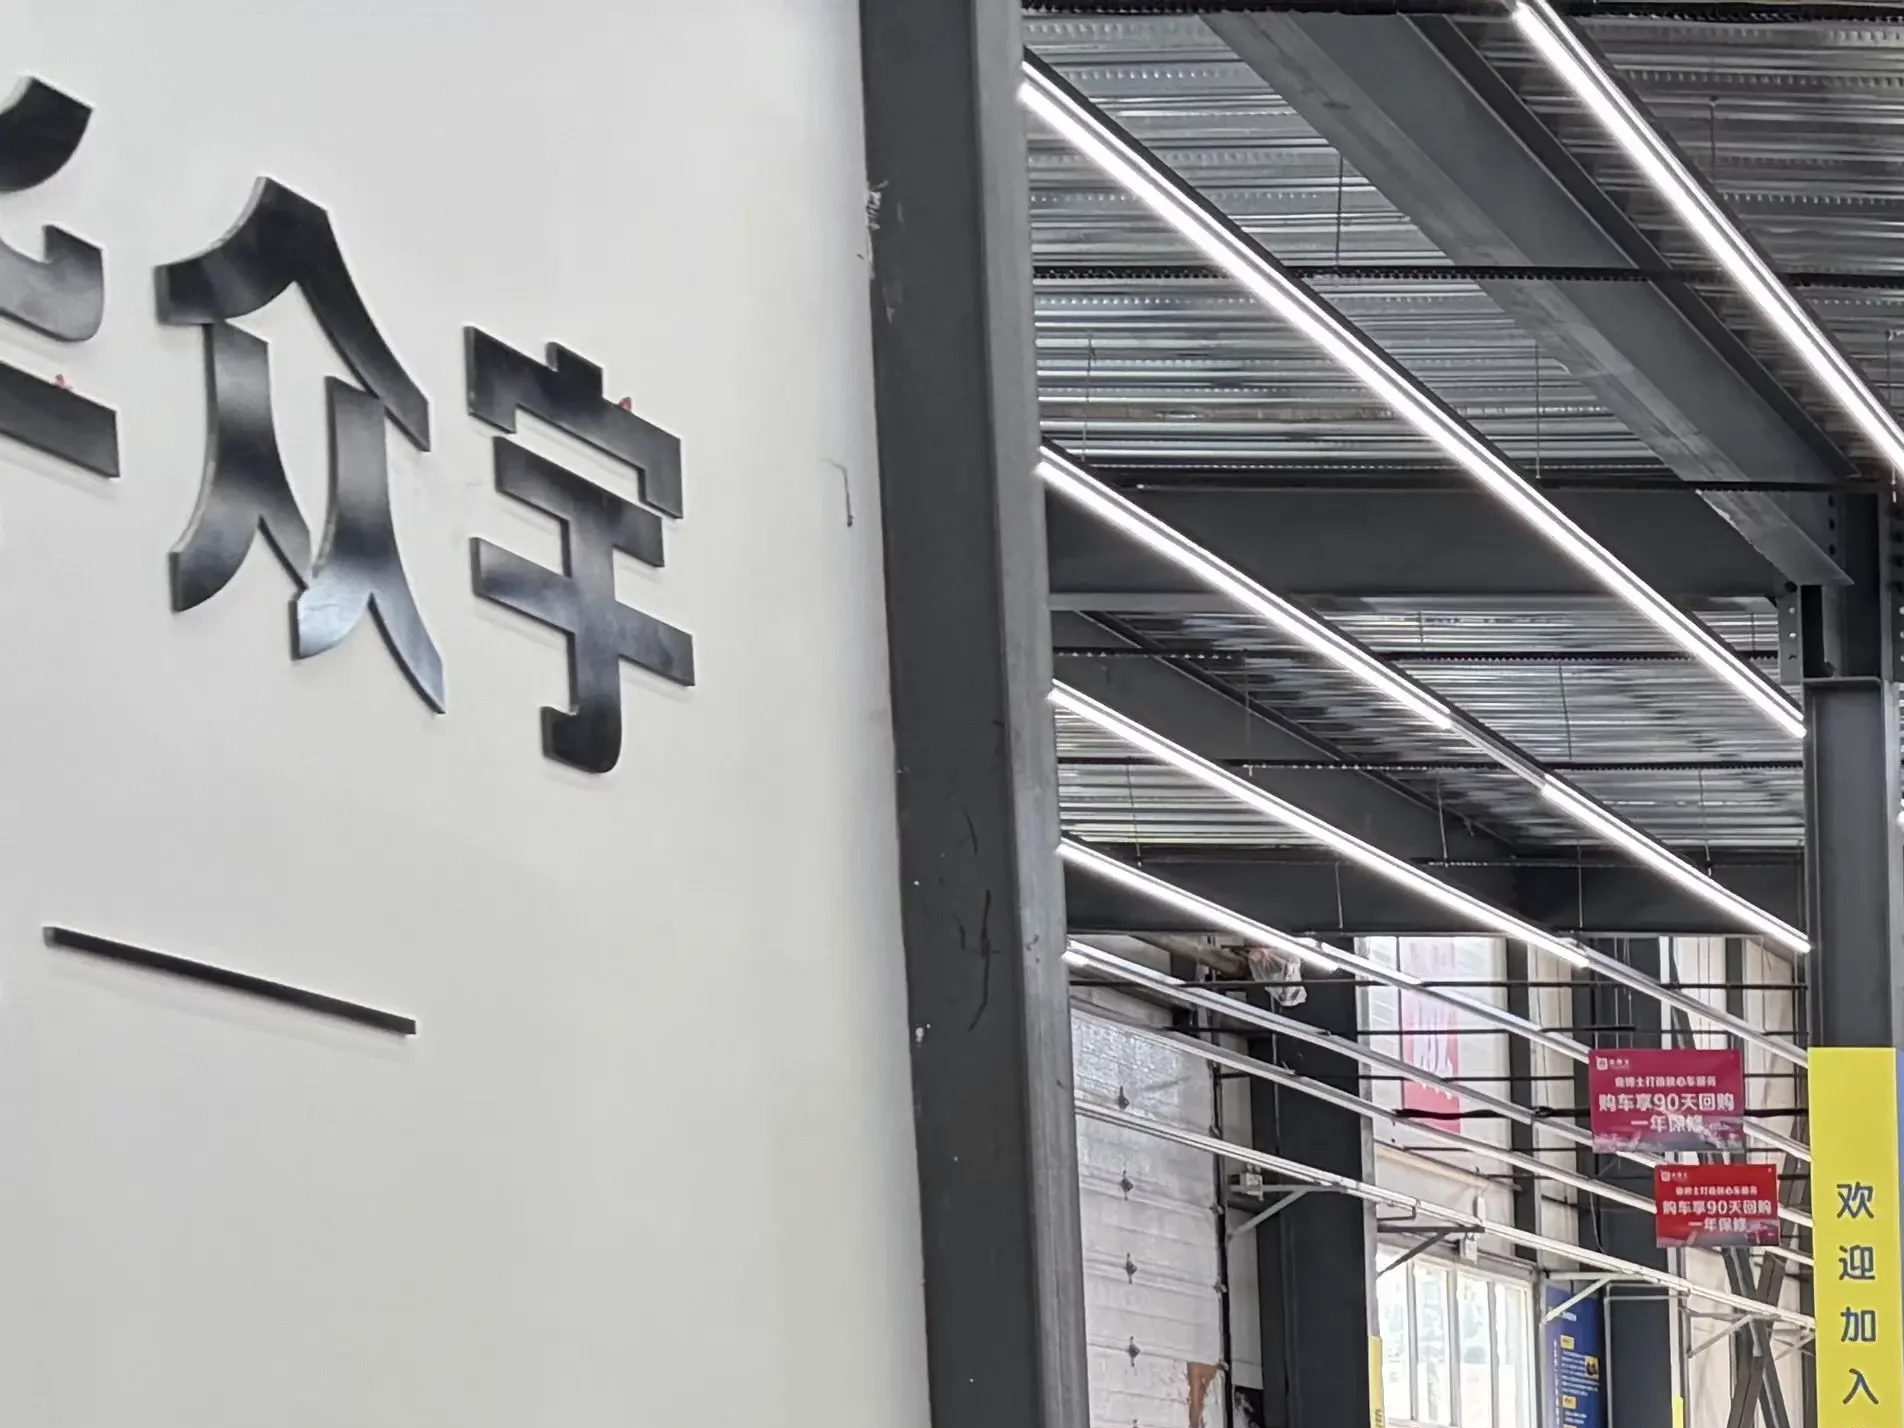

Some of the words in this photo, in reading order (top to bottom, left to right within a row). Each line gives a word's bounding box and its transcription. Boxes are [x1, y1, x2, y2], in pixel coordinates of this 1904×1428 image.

[1599, 1093, 1734, 1112] 购车享90天回购
[1663, 1200, 1771, 1215] 购车享90天回购
